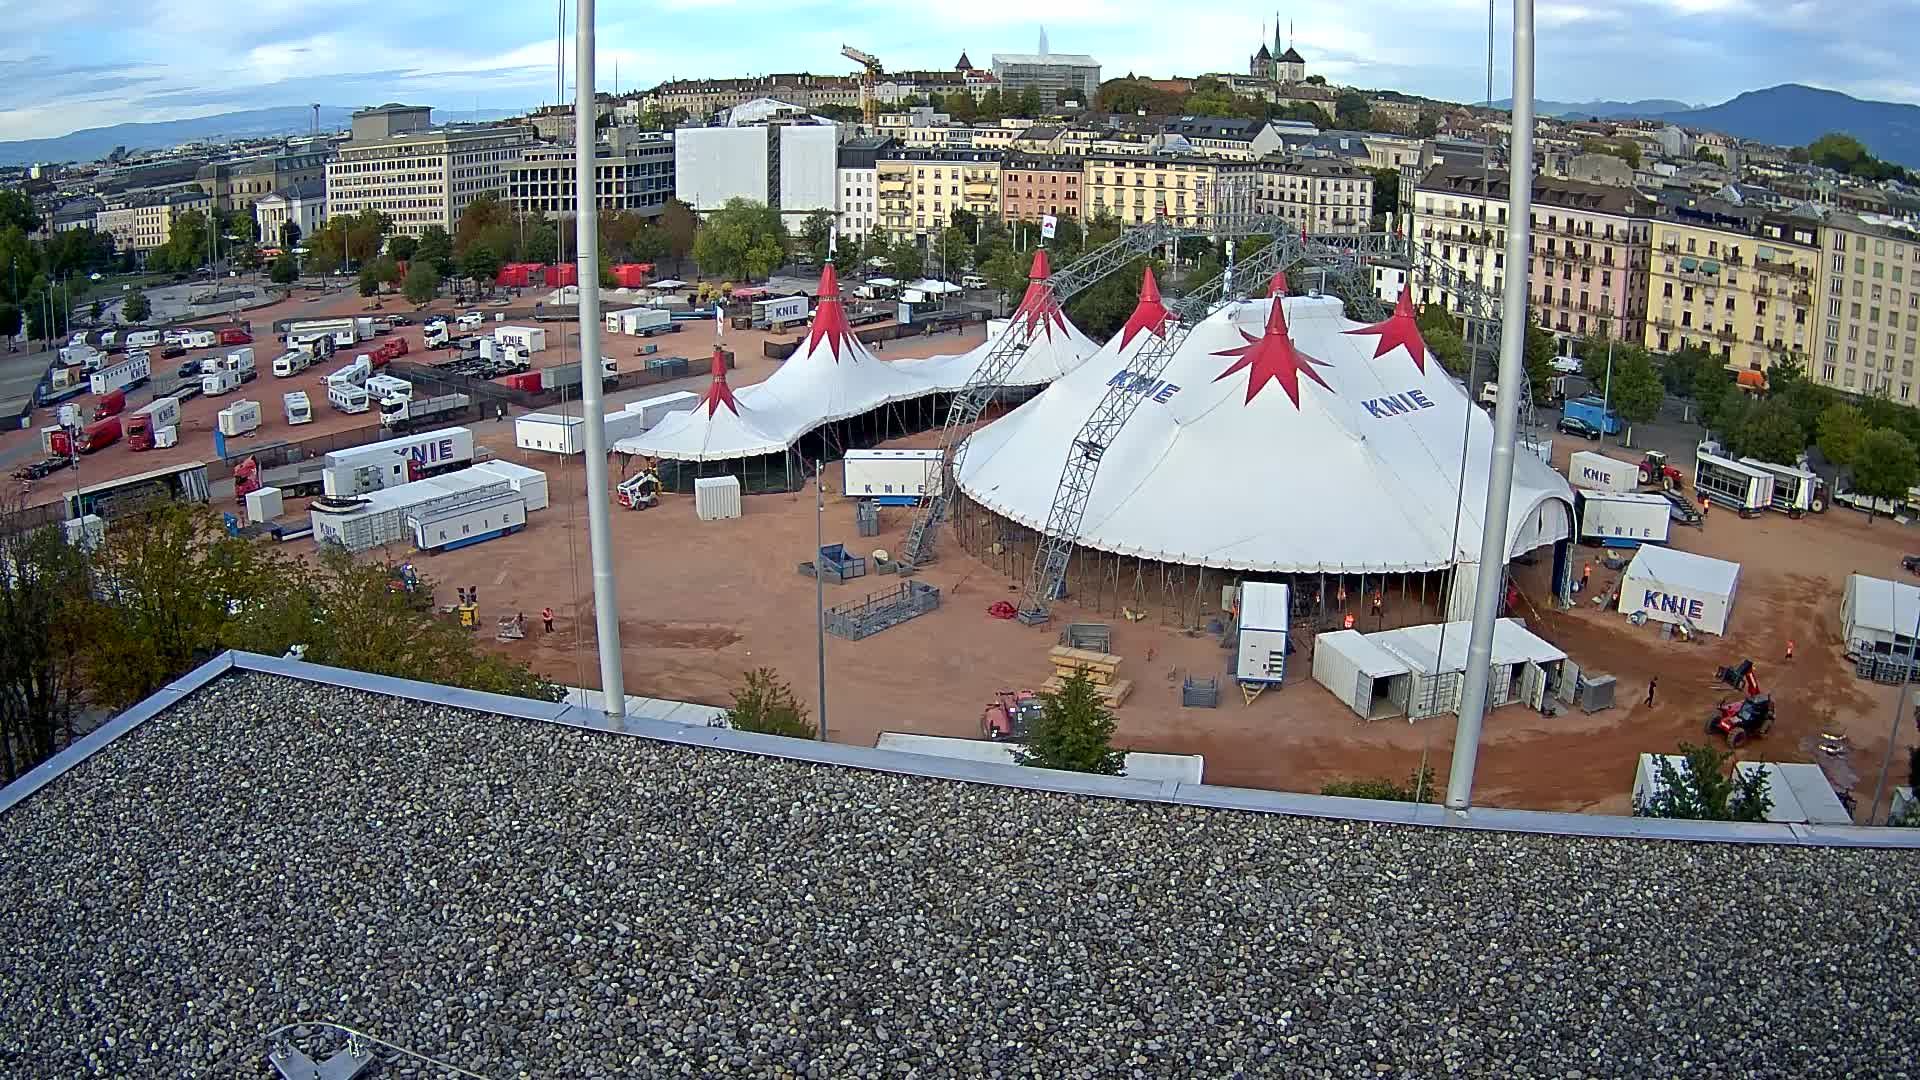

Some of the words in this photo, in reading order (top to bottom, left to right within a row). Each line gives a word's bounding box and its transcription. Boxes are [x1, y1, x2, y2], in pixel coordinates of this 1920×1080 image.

[775, 305, 799, 318] KNIE
[158, 404, 175, 423] KNIE
[1360, 389, 1436, 419] KNIE
[1583, 467, 1611, 485] KNIE
[1643, 589, 1704, 620] KNIE
